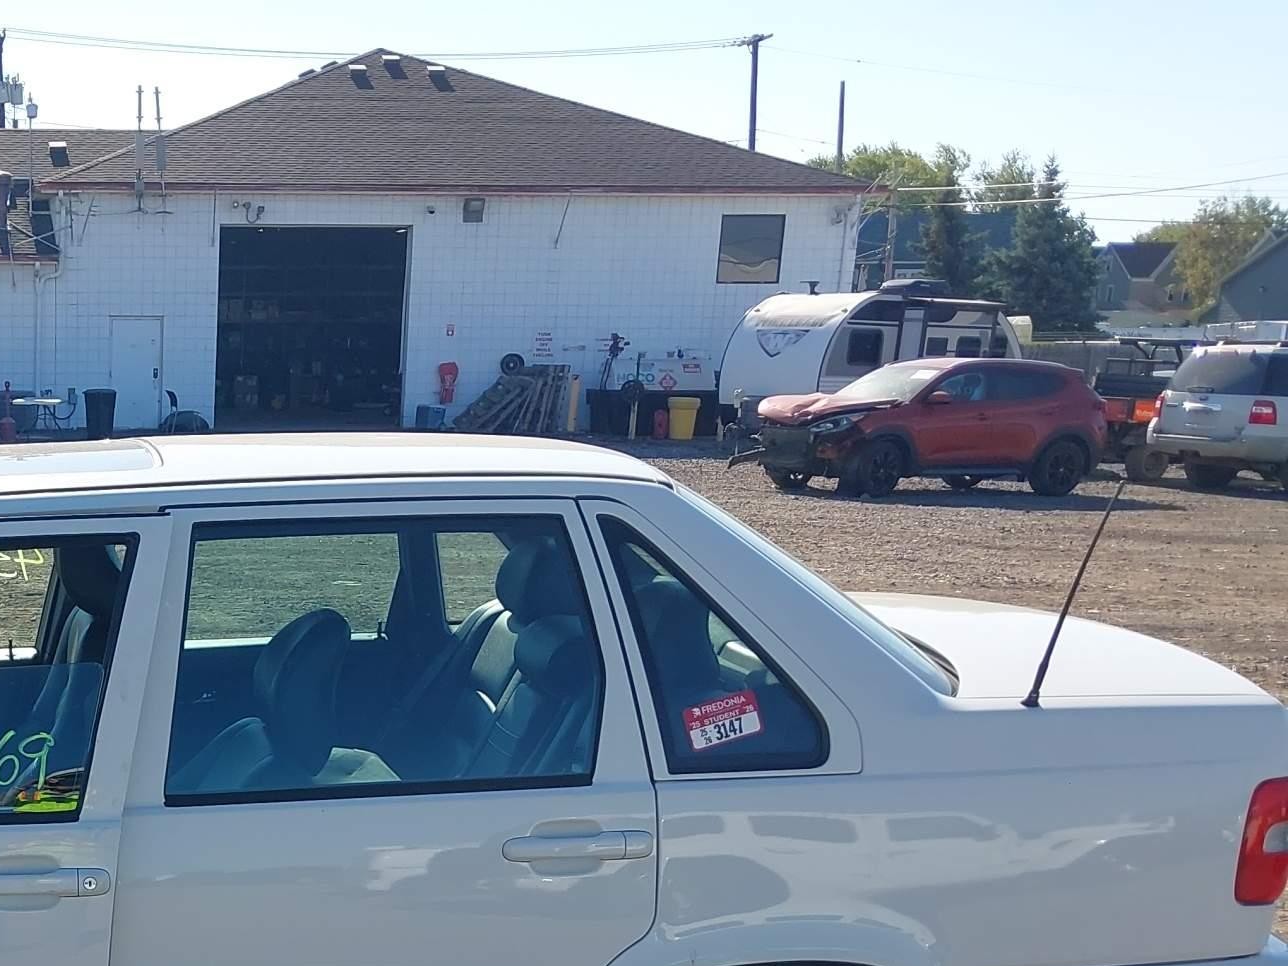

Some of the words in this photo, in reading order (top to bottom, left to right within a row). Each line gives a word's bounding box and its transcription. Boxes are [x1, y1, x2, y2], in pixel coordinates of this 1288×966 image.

[701, 695, 746, 715] FREDONIA
[703, 709, 740, 726] STUDENT
[713, 717, 744, 740] 3147
